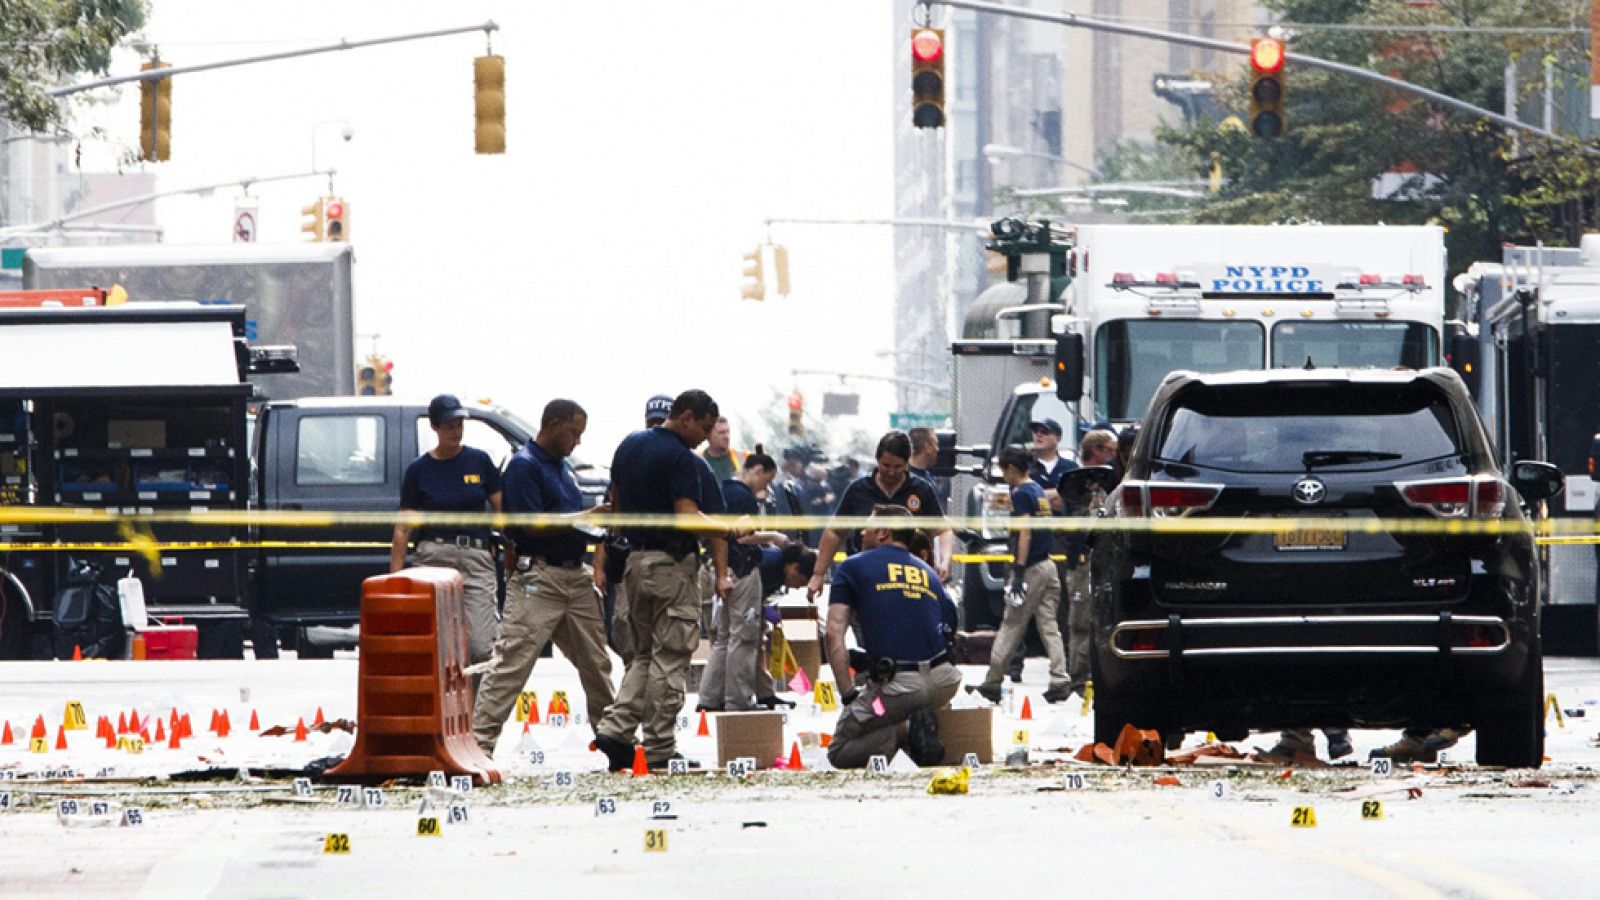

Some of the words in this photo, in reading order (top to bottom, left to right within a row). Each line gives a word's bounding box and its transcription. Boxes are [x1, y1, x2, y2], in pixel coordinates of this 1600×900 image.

[1226, 265, 1310, 278] NYPD
[1212, 279, 1324, 293] POLICE
[887, 563, 930, 588] FBI
[1016, 730, 1023, 743] 4
[36, 739, 43, 752] 7
[530, 751, 544, 765] 39
[1374, 760, 1389, 775] 20
[556, 772, 572, 786] 85
[1065, 774, 1082, 788] 70
[337, 788, 352, 803] 72
[366, 790, 382, 805] 73
[1214, 782, 1223, 798] 3
[61, 801, 78, 815] 69
[93, 802, 108, 816] 67
[598, 798, 616, 814] 63
[1361, 802, 1379, 818] 62
[128, 810, 143, 825] 65
[1292, 808, 1309, 825] 21
[417, 817, 437, 834] 60
[330, 833, 350, 852] 32
[646, 830, 665, 849] 31
